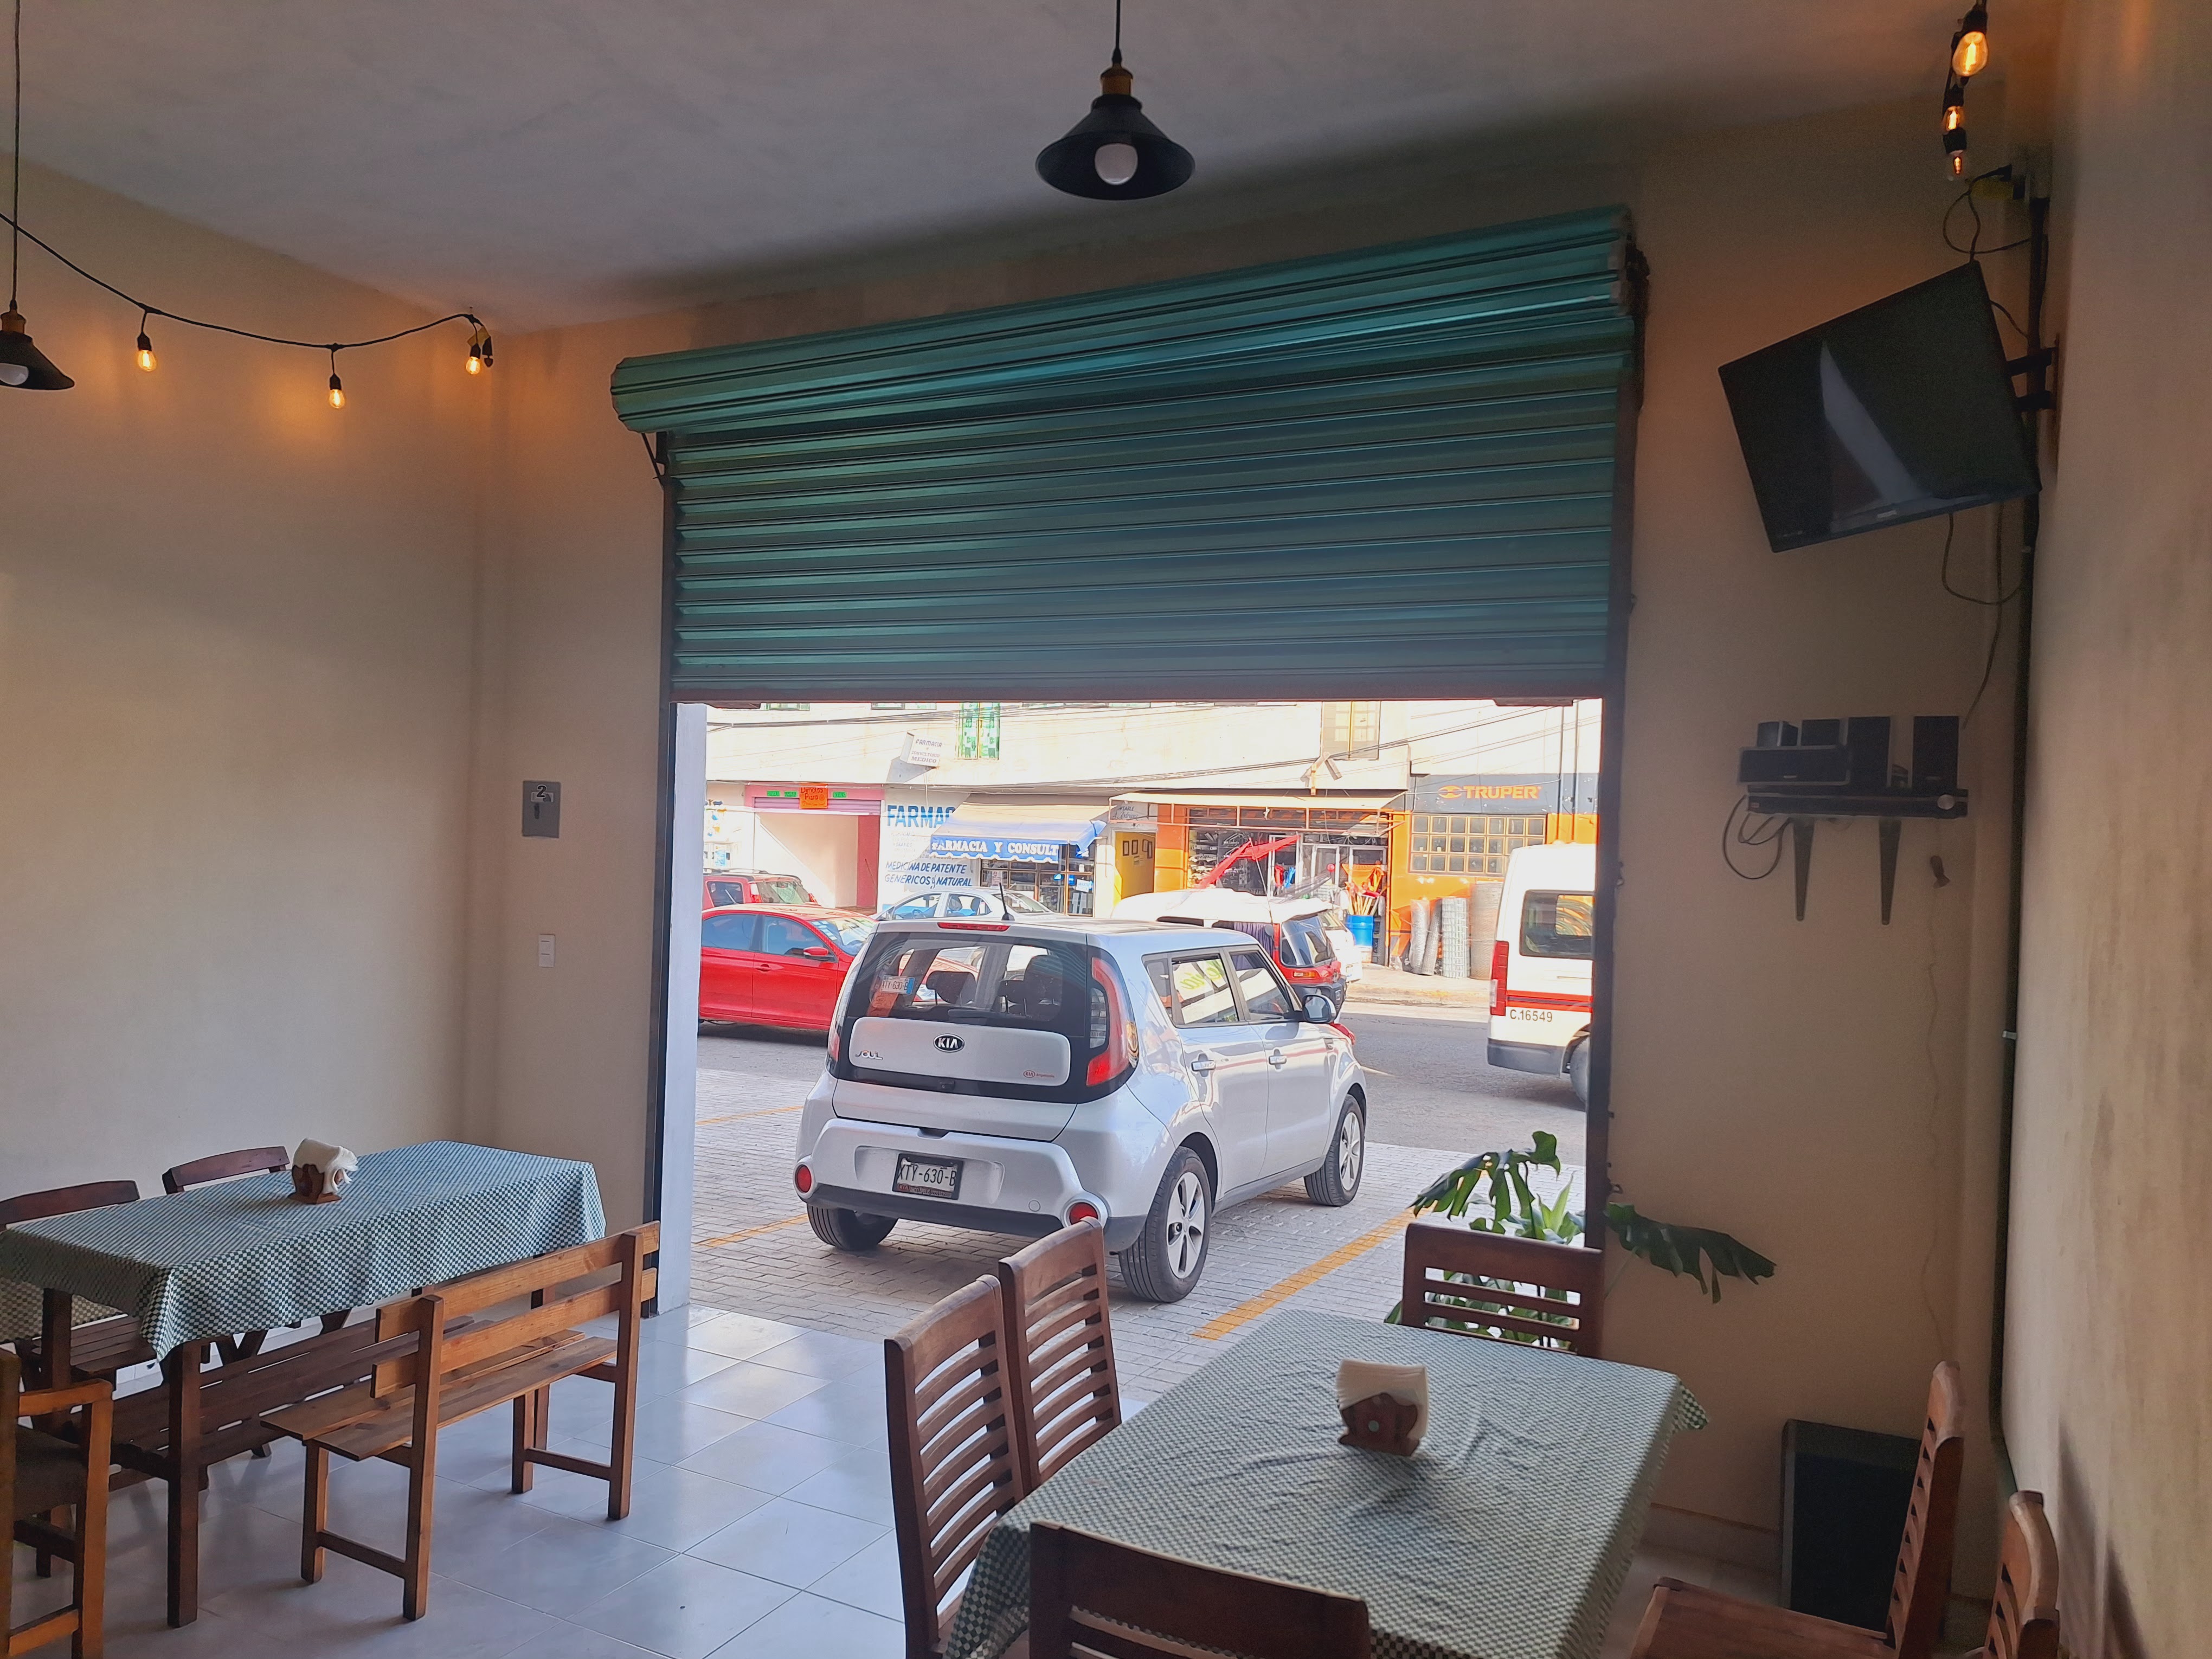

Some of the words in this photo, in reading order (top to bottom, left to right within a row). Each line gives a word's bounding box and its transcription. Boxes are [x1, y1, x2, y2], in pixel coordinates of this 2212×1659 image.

[915, 739, 942, 748] FARMACIA
[536, 784, 546, 798] 2
[1463, 786, 1539, 799] TRUPER
[931, 840, 988, 853] FARMACIA
[994, 842, 1003, 853] Y
[1007, 843, 1059, 856] CONSULT
[885, 861, 920, 872] MEDICINA
[920, 863, 931, 872] DE
[931, 863, 968, 874] PATENTE
[884, 873, 931, 885] GENERICOS
[936, 877, 973, 886] NATURAL
[1509, 1009, 1553, 1023] C.16549
[938, 1037, 959, 1049] KIA
[897, 1164, 957, 1186] XTY-630-B
